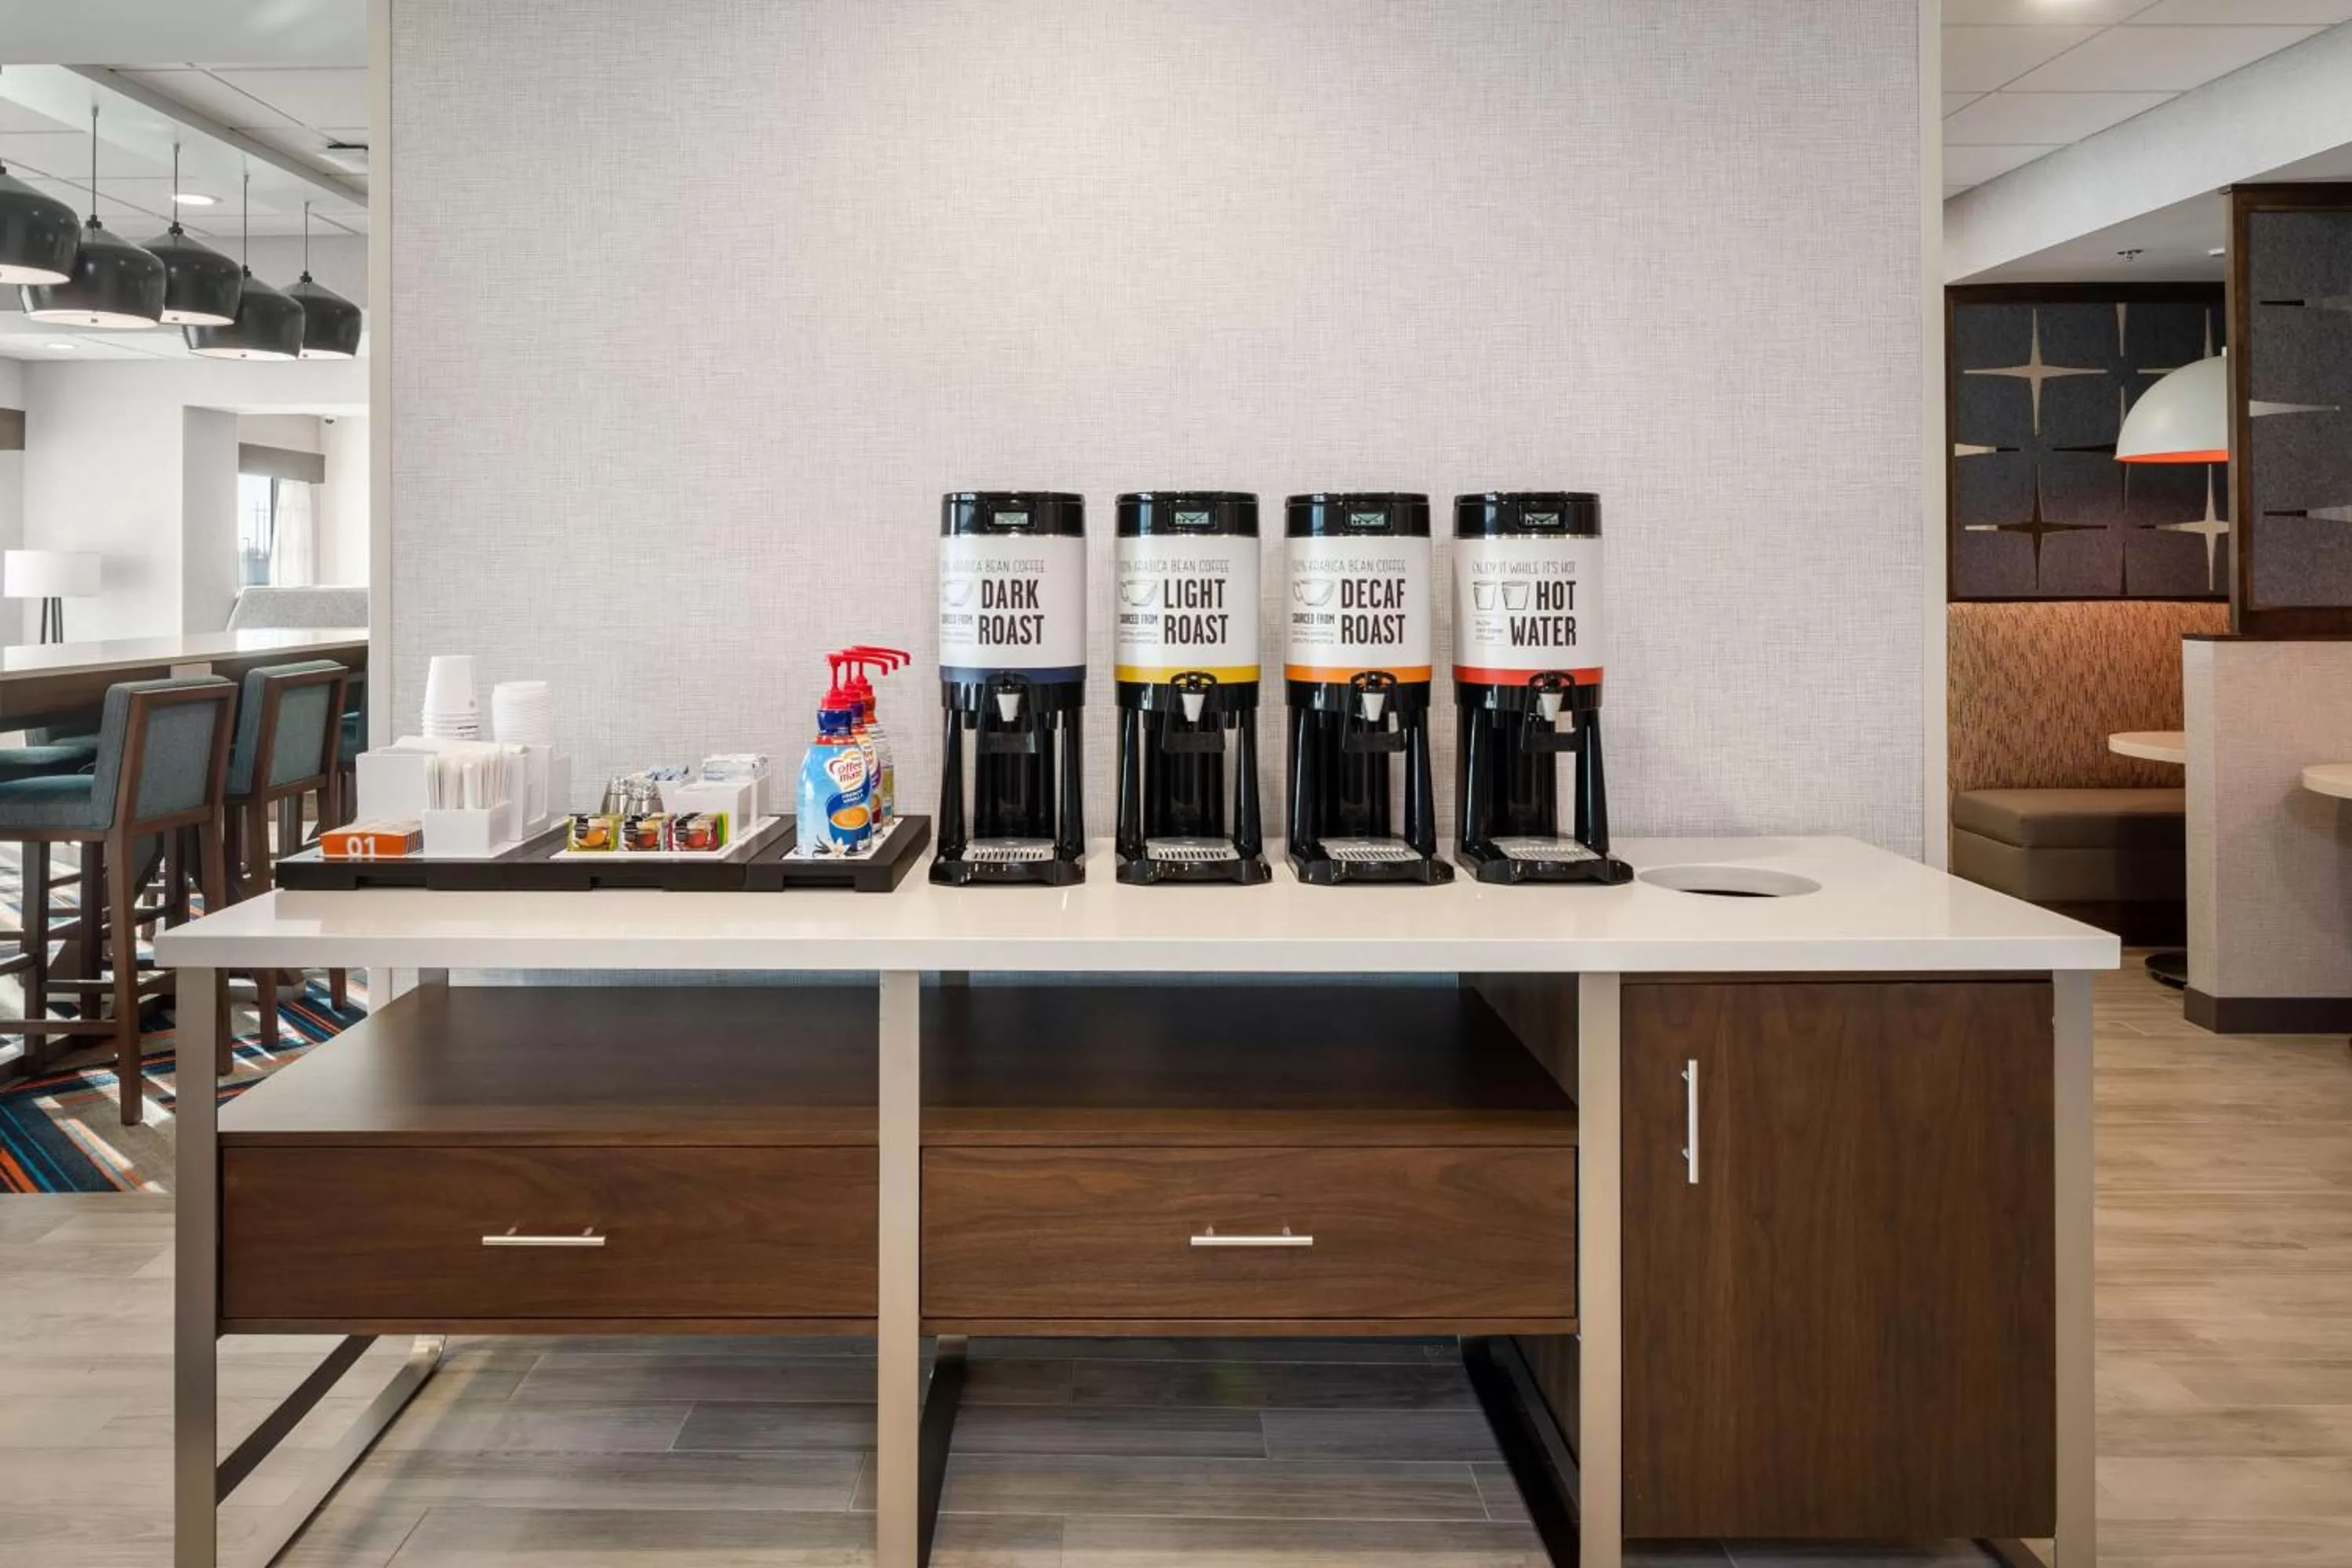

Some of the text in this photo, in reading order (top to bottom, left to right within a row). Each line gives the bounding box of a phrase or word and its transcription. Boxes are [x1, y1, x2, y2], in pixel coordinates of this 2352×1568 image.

[981, 579, 1040, 609] DARK
[1164, 579, 1225, 608] LIGHT
[1341, 579, 1406, 608] DECAF
[1537, 581, 1577, 610] HOT
[978, 615, 1044, 644] ROAST
[1164, 614, 1229, 644] ROAST
[1341, 614, 1406, 644] ROAST
[1510, 616, 1577, 646] WATER
